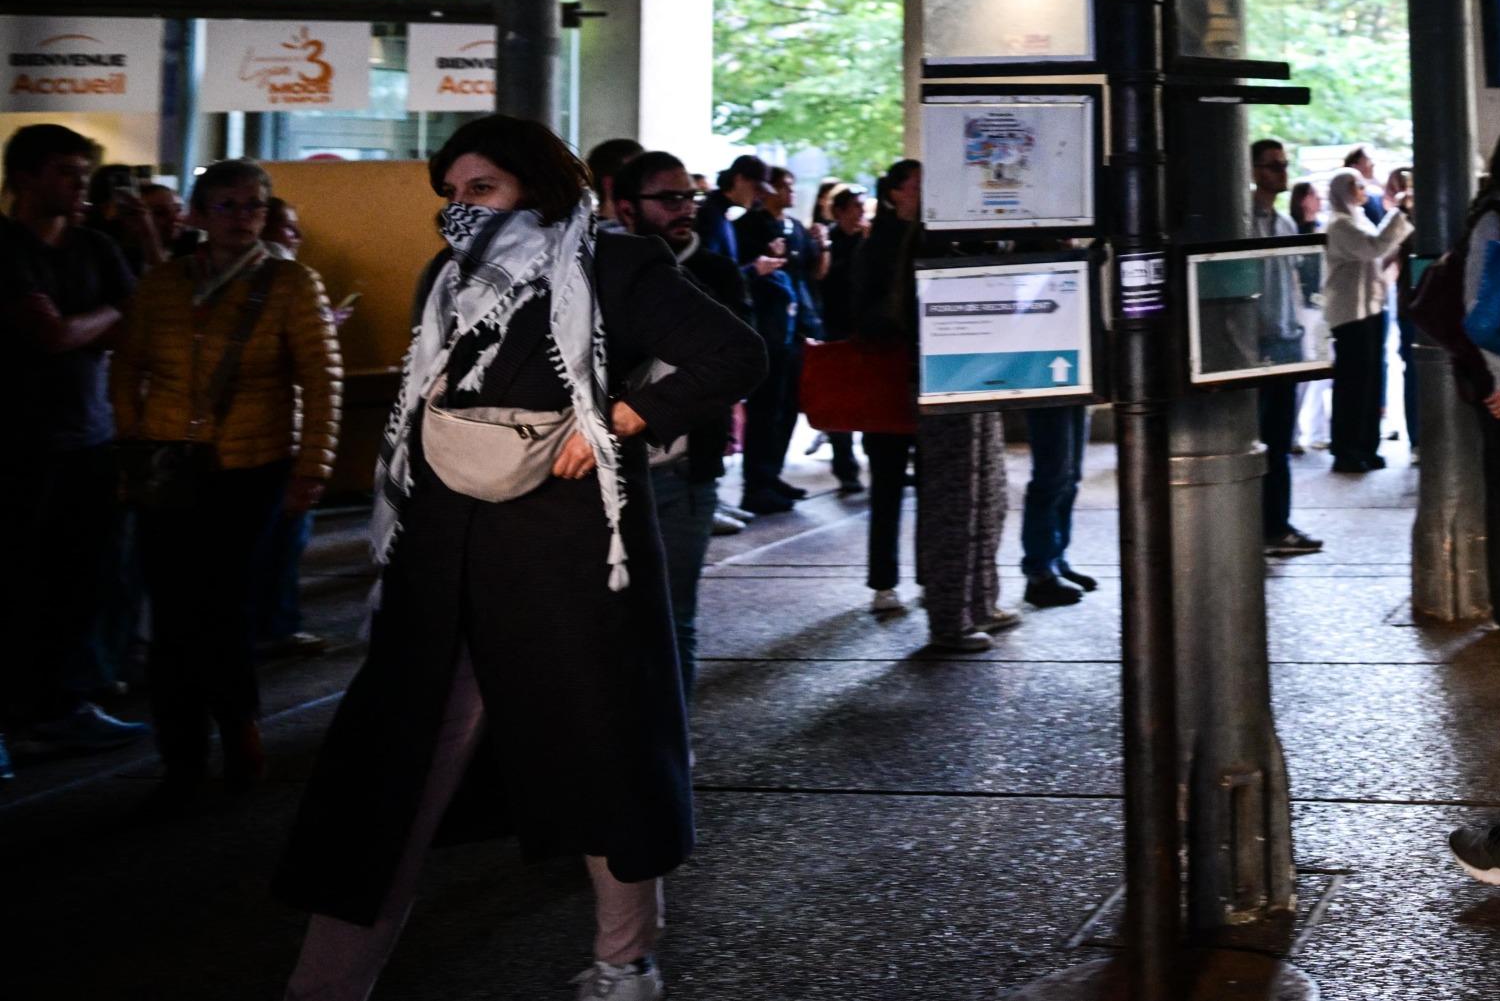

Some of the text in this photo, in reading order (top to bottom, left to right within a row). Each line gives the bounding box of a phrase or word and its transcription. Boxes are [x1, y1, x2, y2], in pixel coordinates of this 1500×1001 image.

[10, 53, 127, 67] BIENVENUE
[437, 57, 497, 69] BIENVE
[9, 72, 126, 95] Accueil
[437, 75, 497, 95] Accu
